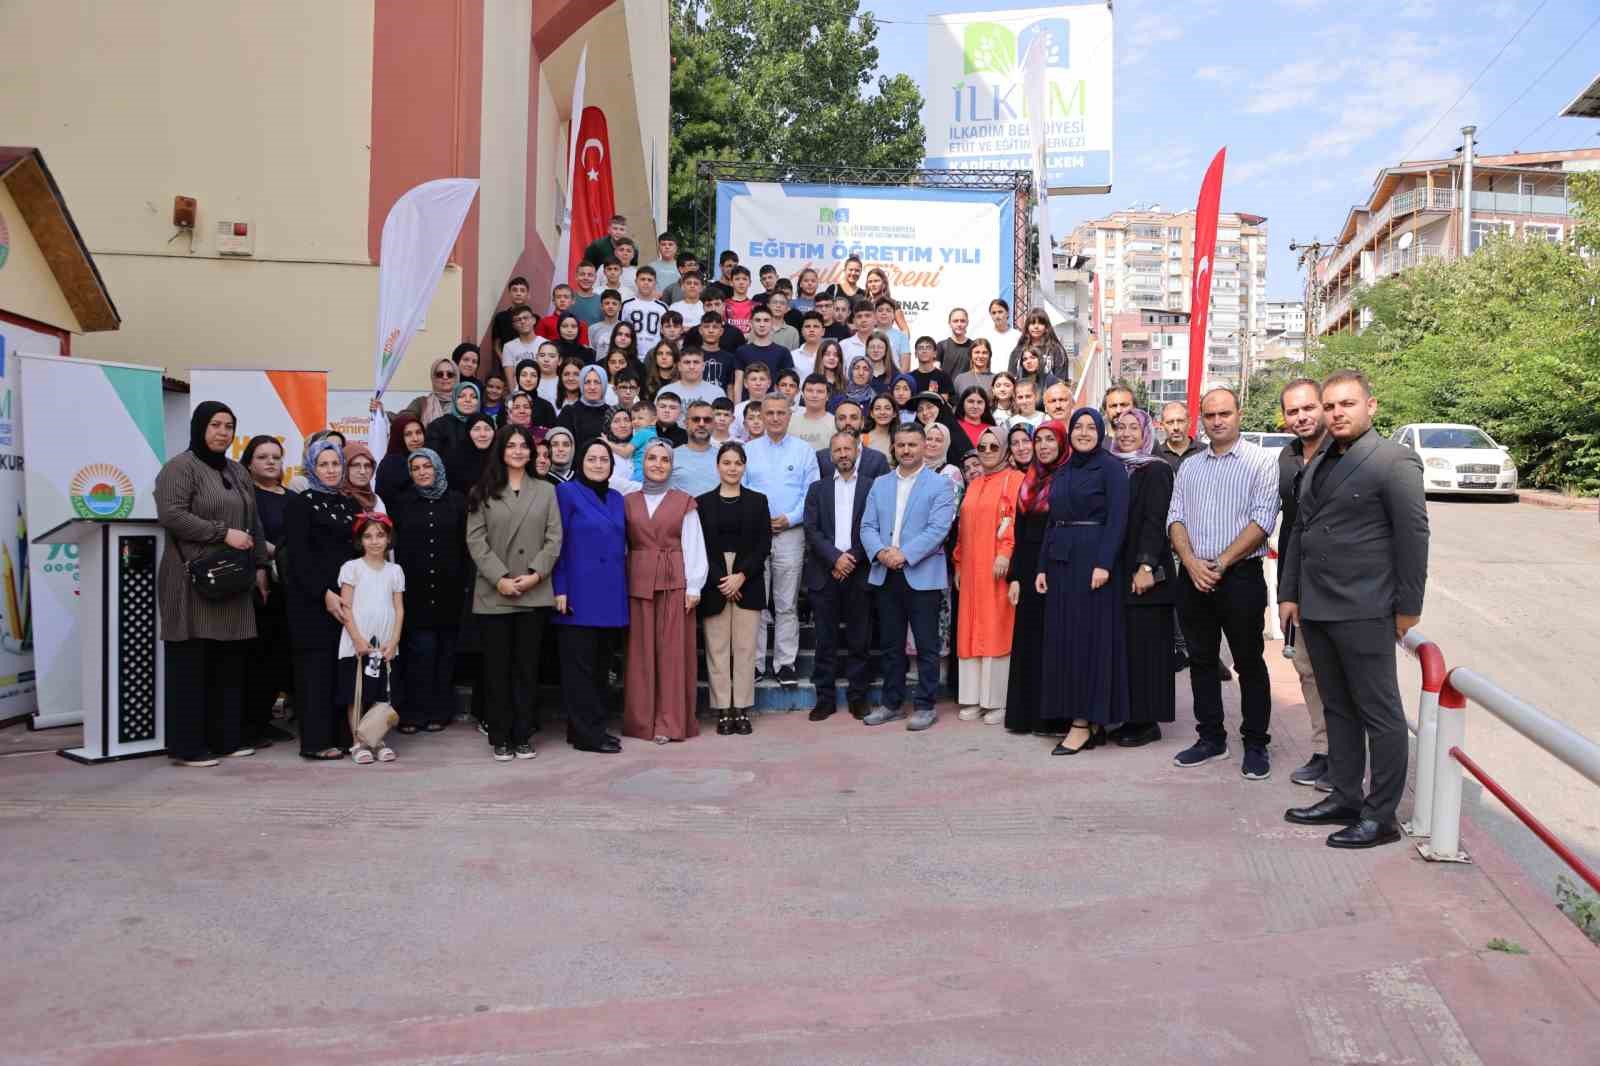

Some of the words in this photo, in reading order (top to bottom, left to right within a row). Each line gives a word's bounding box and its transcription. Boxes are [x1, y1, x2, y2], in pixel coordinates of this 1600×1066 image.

[1047, 155, 1085, 168] LKEM
[749, 238, 824, 260] EĞİTİM
[832, 241, 932, 263] ÖĞRETİM
[939, 248, 981, 264] YILI
[630, 310, 659, 335] 80
